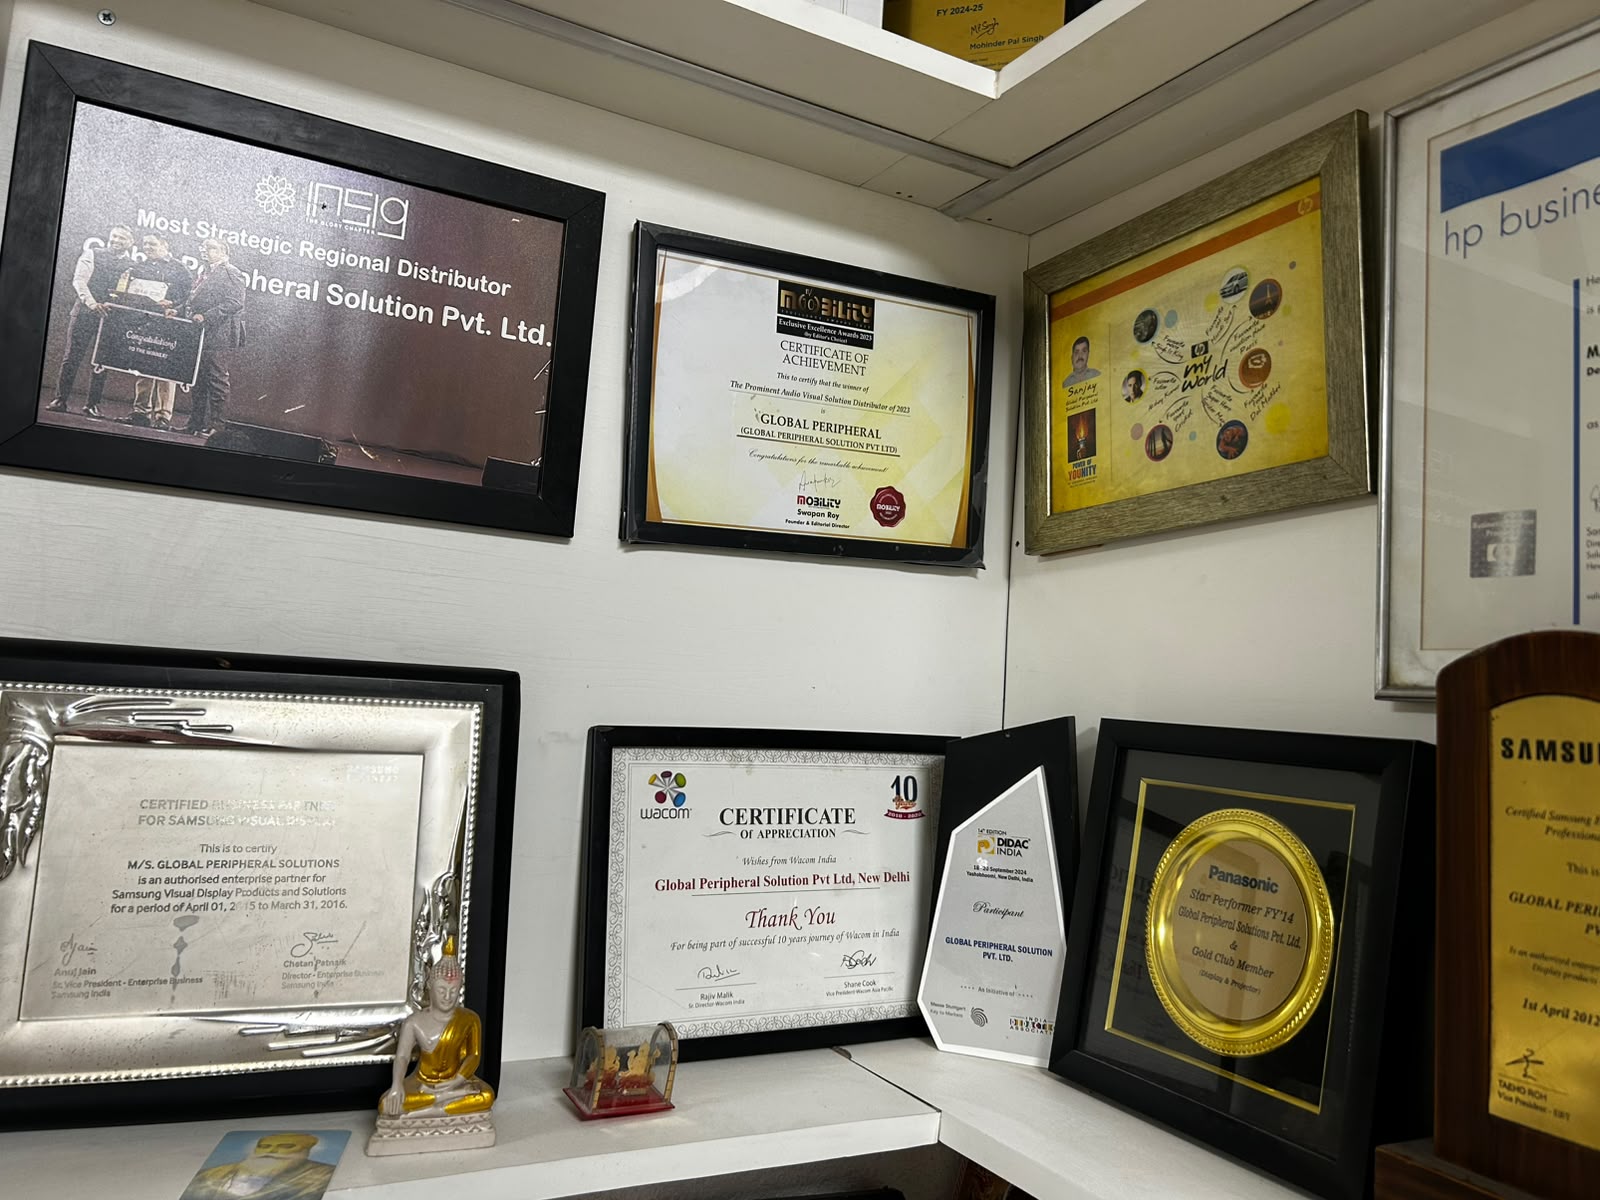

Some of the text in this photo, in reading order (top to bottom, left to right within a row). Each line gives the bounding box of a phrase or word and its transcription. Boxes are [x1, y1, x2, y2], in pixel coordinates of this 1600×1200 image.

[936, 4, 984, 17] FY 2024-25
[969, 40, 1006, 50] Mohinder
[1007, 38, 1020, 46] Pal
[344, 225, 375, 235] CHAPTER
[1445, 220, 1483, 259] hp
[137, 208, 190, 236] Most
[195, 220, 293, 256] Strategic
[299, 239, 391, 274] Regional
[397, 258, 512, 297] Distributor
[326, 283, 434, 325] Solution
[441, 305, 492, 336] Pvt.
[500, 316, 552, 347] Ltd.
[779, 318, 807, 330] Exclusive
[807, 323, 837, 335] Excellence
[837, 329, 859, 339] Awards
[859, 333, 873, 341] 2023
[780, 340, 869, 364] CERTIFICATE OF
[782, 353, 866, 376] ACHIEVEMENT
[776, 372, 790, 381] This
[798, 377, 818, 387] certify
[818, 379, 831, 387] that
[831, 380, 841, 388] the
[842, 383, 862, 392] winner
[1067, 382, 1097, 398] Sanjay
[730, 380, 743, 390] The
[744, 382, 781, 396] Prominent
[781, 387, 801, 399] Audio
[802, 390, 824, 402] Visual
[824, 393, 852, 406] Solution
[852, 397, 888, 411] Distributor
[896, 404, 911, 414] 2023
[760, 413, 882, 440] GLOBAL PERIPHERAL
[740, 425, 898, 454] (GLOBAL PERIPHERAL SOLUTION PVT LTD)
[785, 518, 805, 526] Founder
[797, 508, 840, 520] Swapan Roy
[1500, 737, 1600, 765] SAMSU
[890, 775, 918, 803] 10
[139, 799, 208, 811] CERTIFIED
[640, 807, 690, 819] wacom
[138, 814, 166, 826] FOR
[719, 807, 857, 826] CERTIFICATE
[1505, 806, 1592, 827] Certified Samsung
[757, 828, 837, 840] APPRECIATION
[997, 837, 1029, 849] DIDAC
[200, 843, 277, 855] This is to certify
[996, 847, 1023, 857] INDIA
[127, 859, 340, 870] M/S. GLOBAL PERIPHERAL SOLUTIONS
[742, 854, 837, 868] Wishes from Wacom India
[1567, 862, 1588, 875] This
[138, 873, 326, 885] is an authorised enterprise partner for
[654, 871, 910, 892] Global Peripheral Solution Pvt Ltd, New Delhi
[1208, 865, 1279, 894] Panasonic
[112, 886, 347, 900] Samsung Visual Display Products and Solutions
[1508, 891, 1562, 911] GLOBAL
[111, 903, 126, 914] for
[136, 903, 170, 915] period
[172, 903, 184, 913] of
[185, 902, 209, 913] April
[258, 901, 269, 910] to
[270, 900, 301, 910] March
[302, 901, 318, 910] 31,
[320, 900, 348, 909] 2016.
[972, 901, 1024, 919] Participant
[1189, 888, 1295, 924] Star Performer FY'14
[745, 905, 836, 931] Thank You
[1178, 906, 1302, 949] Global Peripheral Solutions Pvt. Ltd.
[670, 928, 900, 951] For being part of successful 10 years journey of Wacom in India
[945, 936, 1053, 957] GLOBAL PERIPHERAL SOLUTION
[1229, 941, 1238, 951] &
[982, 951, 1014, 962] PVT. LTD.
[1192, 946, 1275, 979] Gold Club Member
[83, 979, 121, 988] President
[128, 978, 168, 988] Enterprise
[843, 979, 877, 989] Shane Cook
[700, 991, 733, 1001] Rajiv Malik
[1522, 997, 1570, 1020] 1st April
